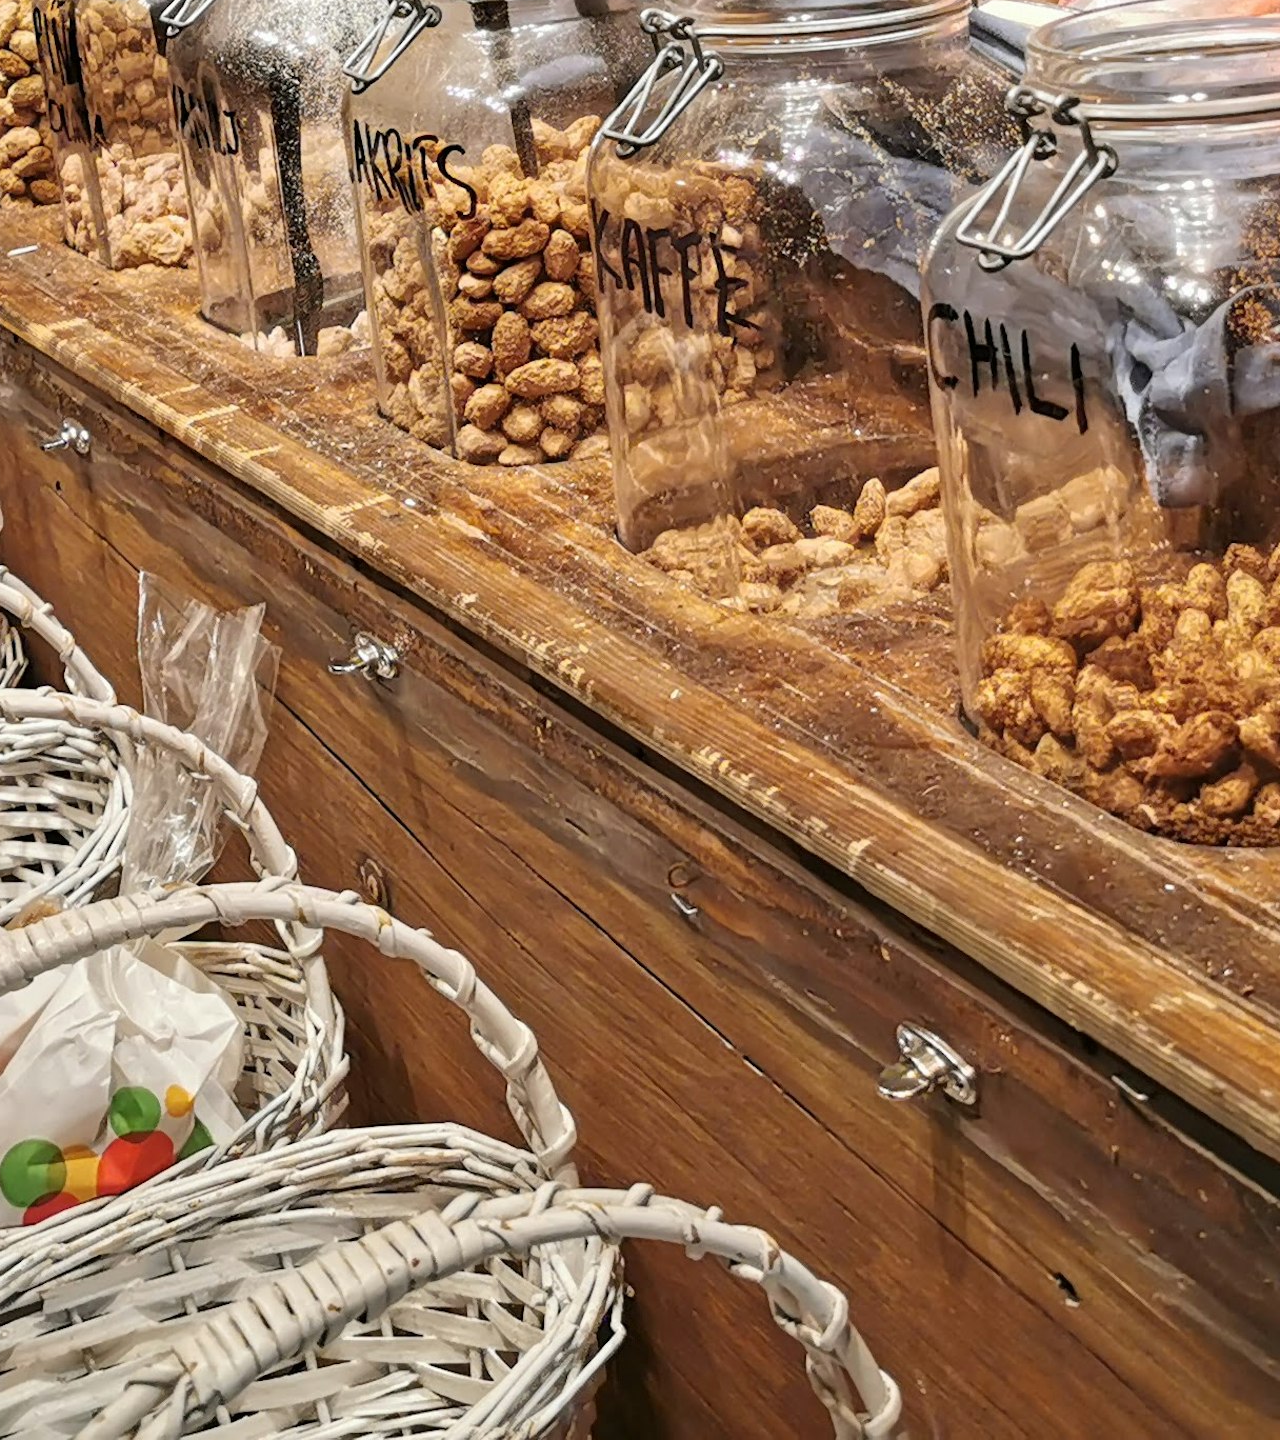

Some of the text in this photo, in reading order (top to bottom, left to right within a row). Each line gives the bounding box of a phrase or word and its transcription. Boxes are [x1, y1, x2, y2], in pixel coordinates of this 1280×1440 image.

[349, 118, 478, 220] AKRITS
[589, 197, 763, 338] KAFFE
[928, 302, 1088, 435] CHILI
